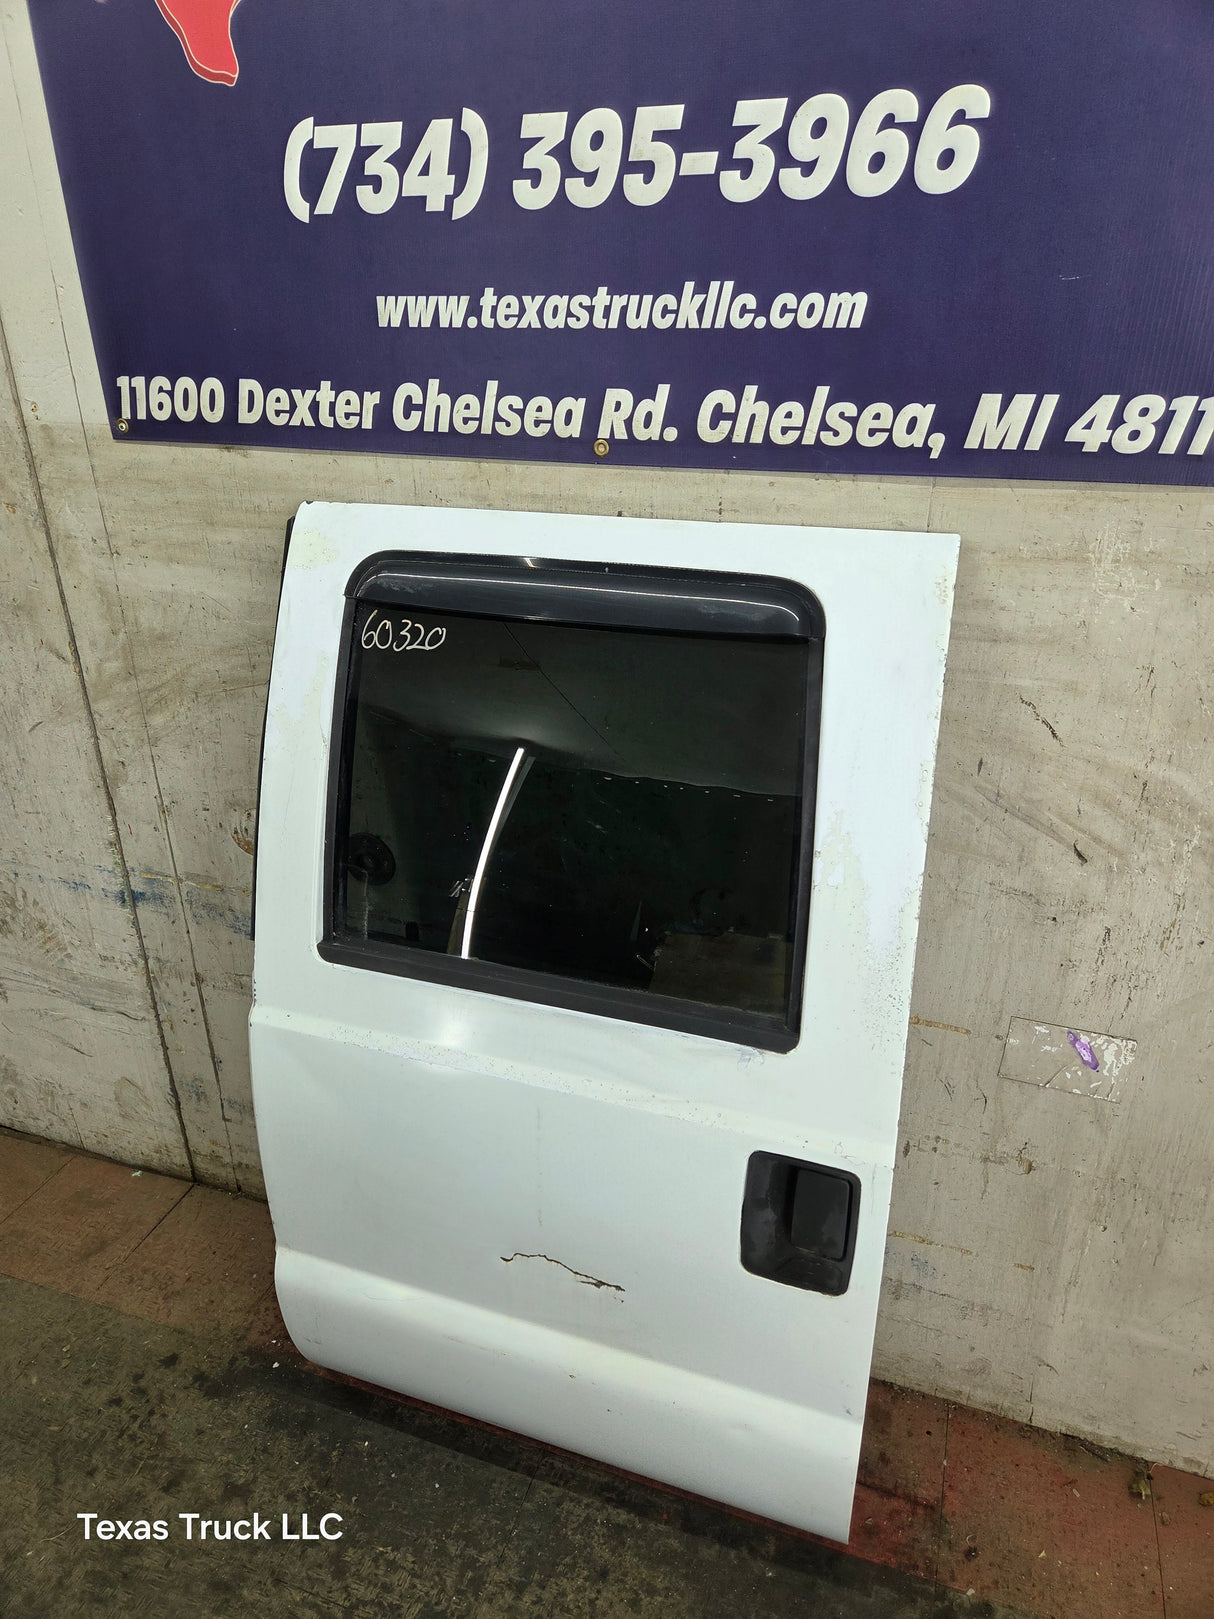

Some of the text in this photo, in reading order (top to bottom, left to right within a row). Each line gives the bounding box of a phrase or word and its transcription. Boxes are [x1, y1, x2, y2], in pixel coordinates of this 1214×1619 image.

[283, 83, 992, 224] (734) 395-3966
[376, 280, 868, 330] www.texastruckllc.com
[116, 376, 225, 422] 11600
[237, 378, 381, 430] Dexter
[393, 378, 587, 438] Chelsea
[598, 383, 678, 442] Rd.
[696, 384, 946, 459] Chelsea,
[963, 393, 1061, 451] MI
[361, 609, 447, 652] 60320
